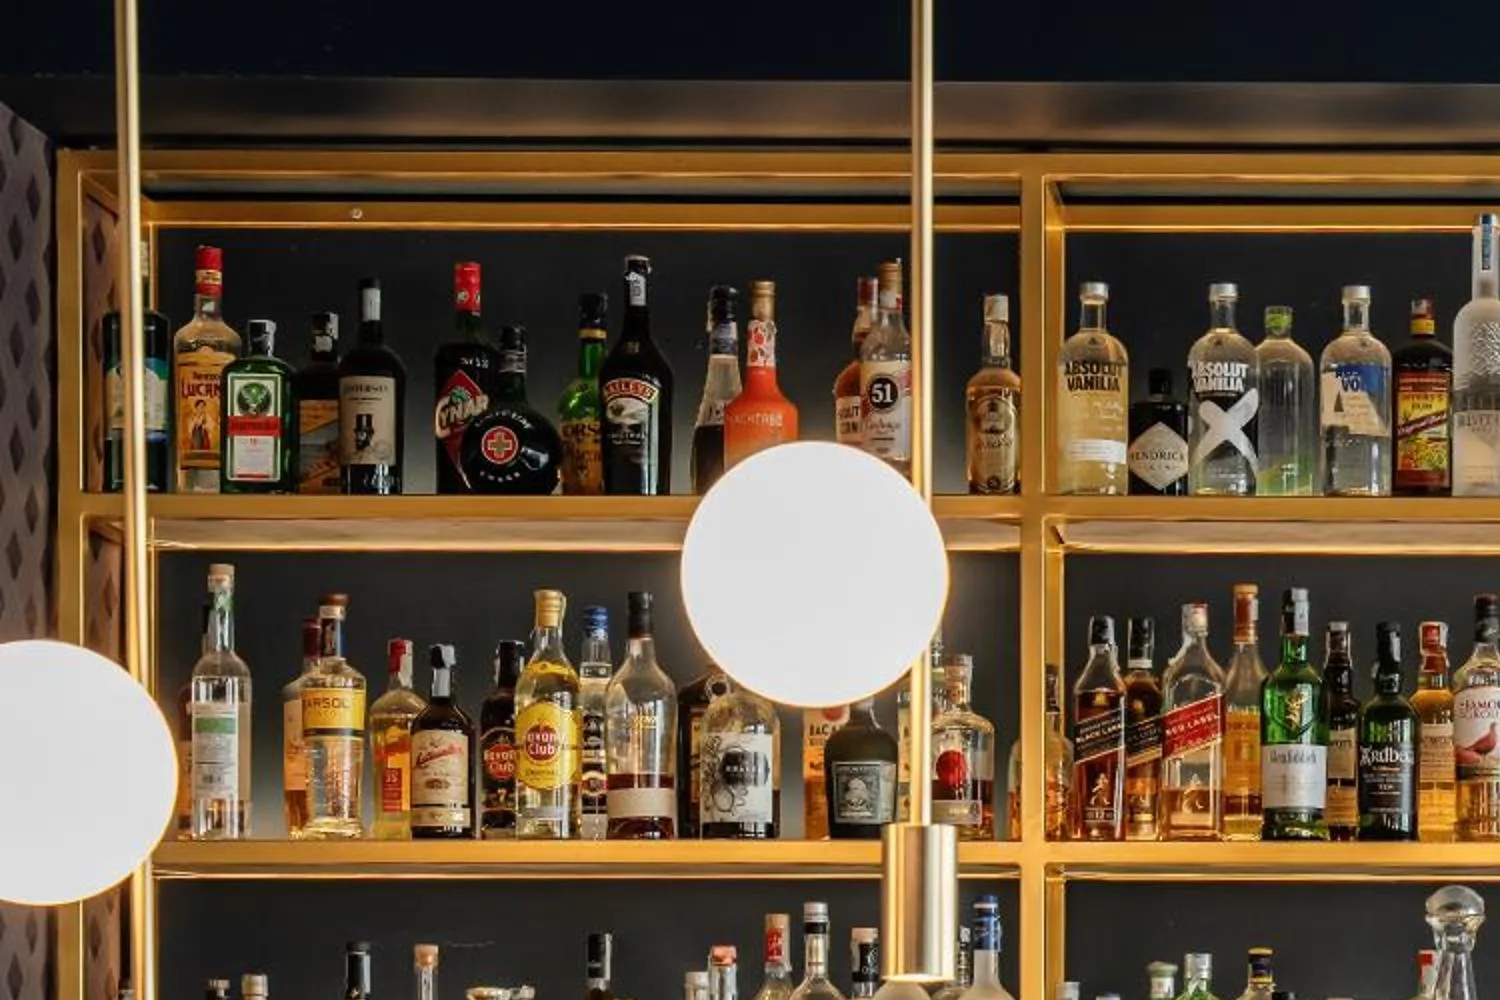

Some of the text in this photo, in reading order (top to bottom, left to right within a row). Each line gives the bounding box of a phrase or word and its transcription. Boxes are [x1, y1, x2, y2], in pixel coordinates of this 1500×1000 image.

[1064, 360, 1122, 376] ABSOLUT
[1189, 361, 1247, 378] ABSOLUT
[181, 382, 221, 398] LUCAN
[871, 382, 893, 404] 51
[1191, 713, 1221, 732] LABEL
[528, 743, 555, 755] Club
